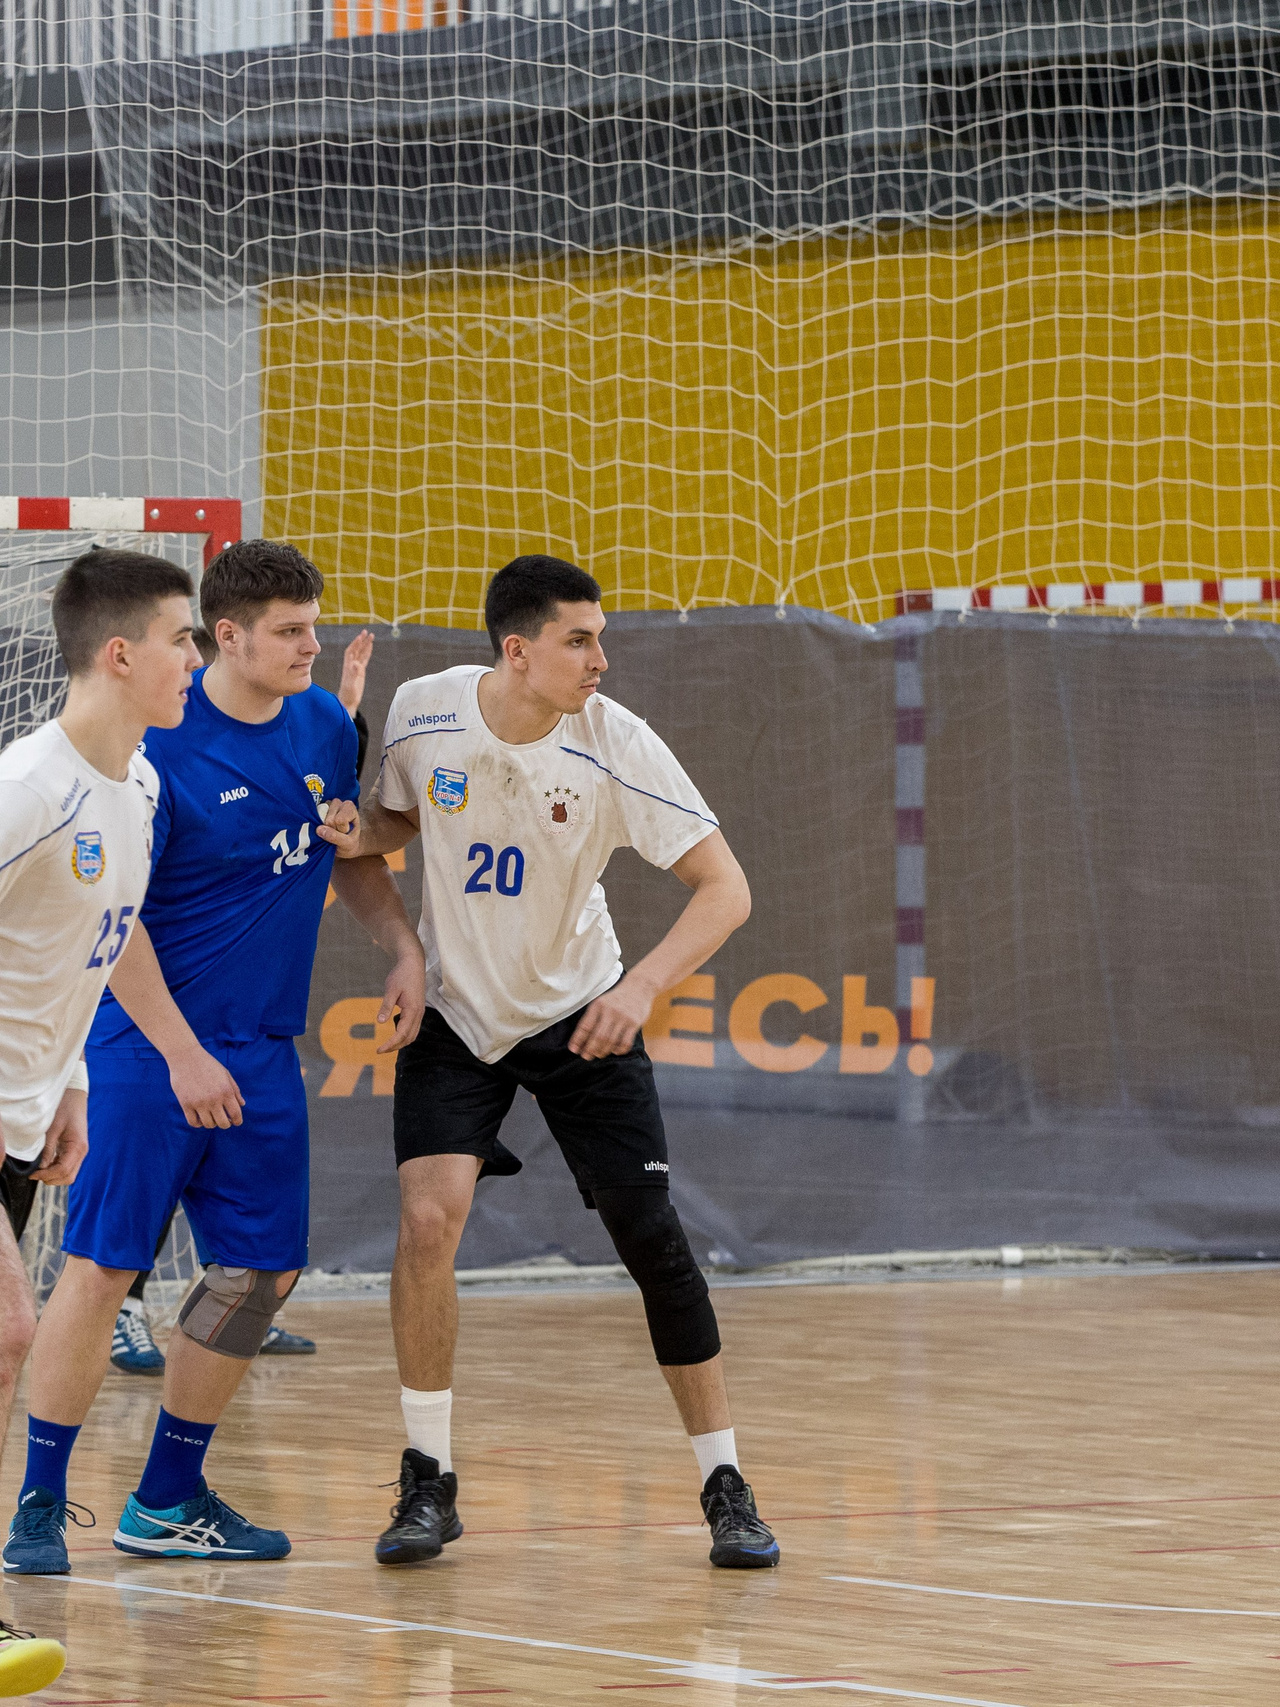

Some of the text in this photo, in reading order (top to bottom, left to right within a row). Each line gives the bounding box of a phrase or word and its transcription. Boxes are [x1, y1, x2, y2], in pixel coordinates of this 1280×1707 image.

[408, 712, 457, 728] uhlsport
[220, 786, 249, 805] JAKO
[270, 822, 311, 875] 14
[465, 842, 525, 897] 20
[86, 906, 135, 970] 25
[164, 1431, 205, 1446] JAKO
